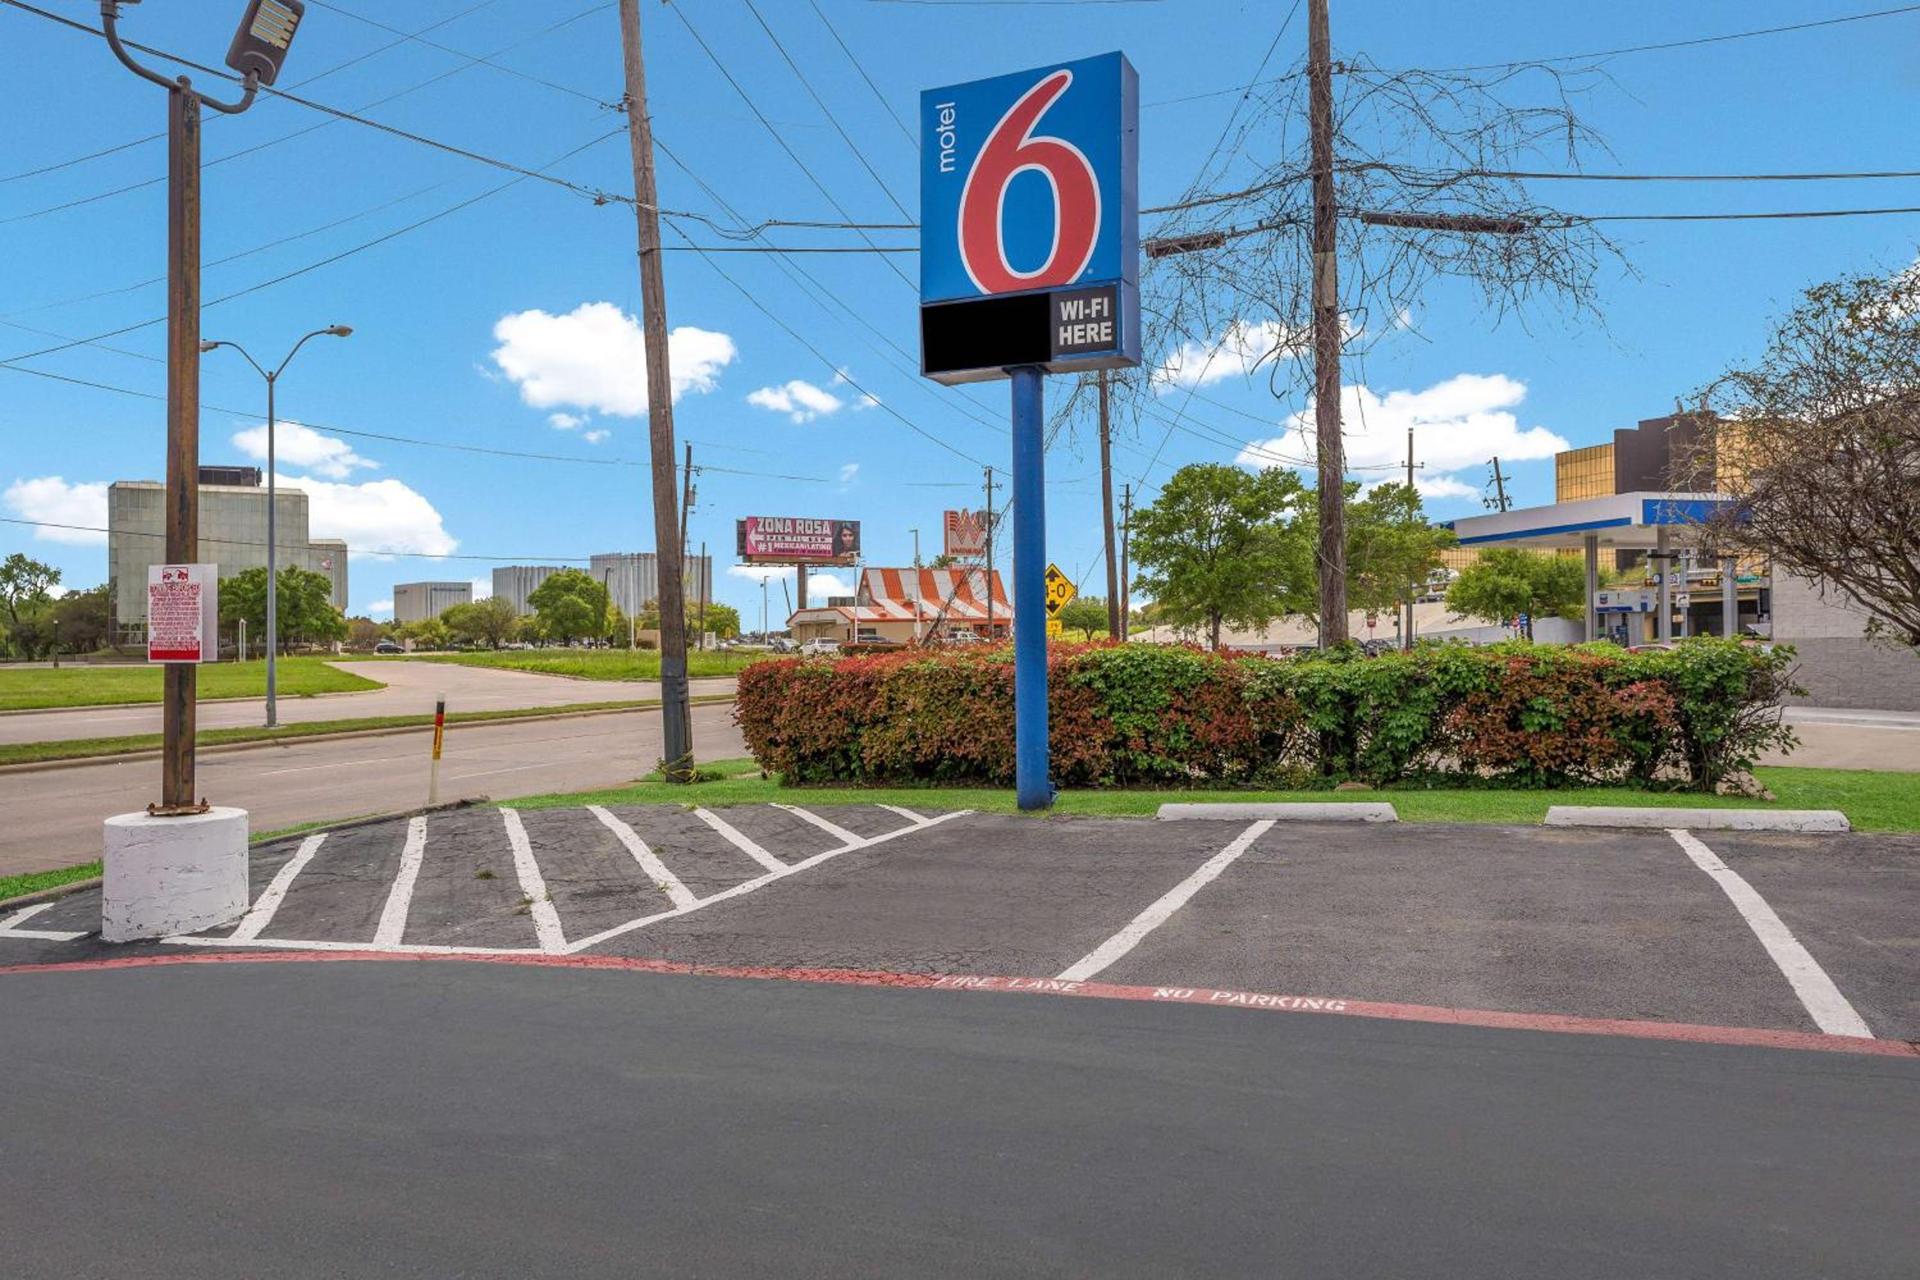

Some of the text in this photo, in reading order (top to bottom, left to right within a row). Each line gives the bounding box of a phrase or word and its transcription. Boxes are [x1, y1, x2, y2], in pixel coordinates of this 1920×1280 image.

[936, 101, 956, 173] motel
[958, 69, 1102, 295] 6
[1060, 297, 1109, 321] WI-FI
[1059, 321, 1112, 345] HERE
[757, 518, 832, 536] ZONA ROSA
[1007, 977, 1086, 992] LANE
[1153, 988, 1195, 999] NO
[1210, 991, 1347, 1011] PARKING
